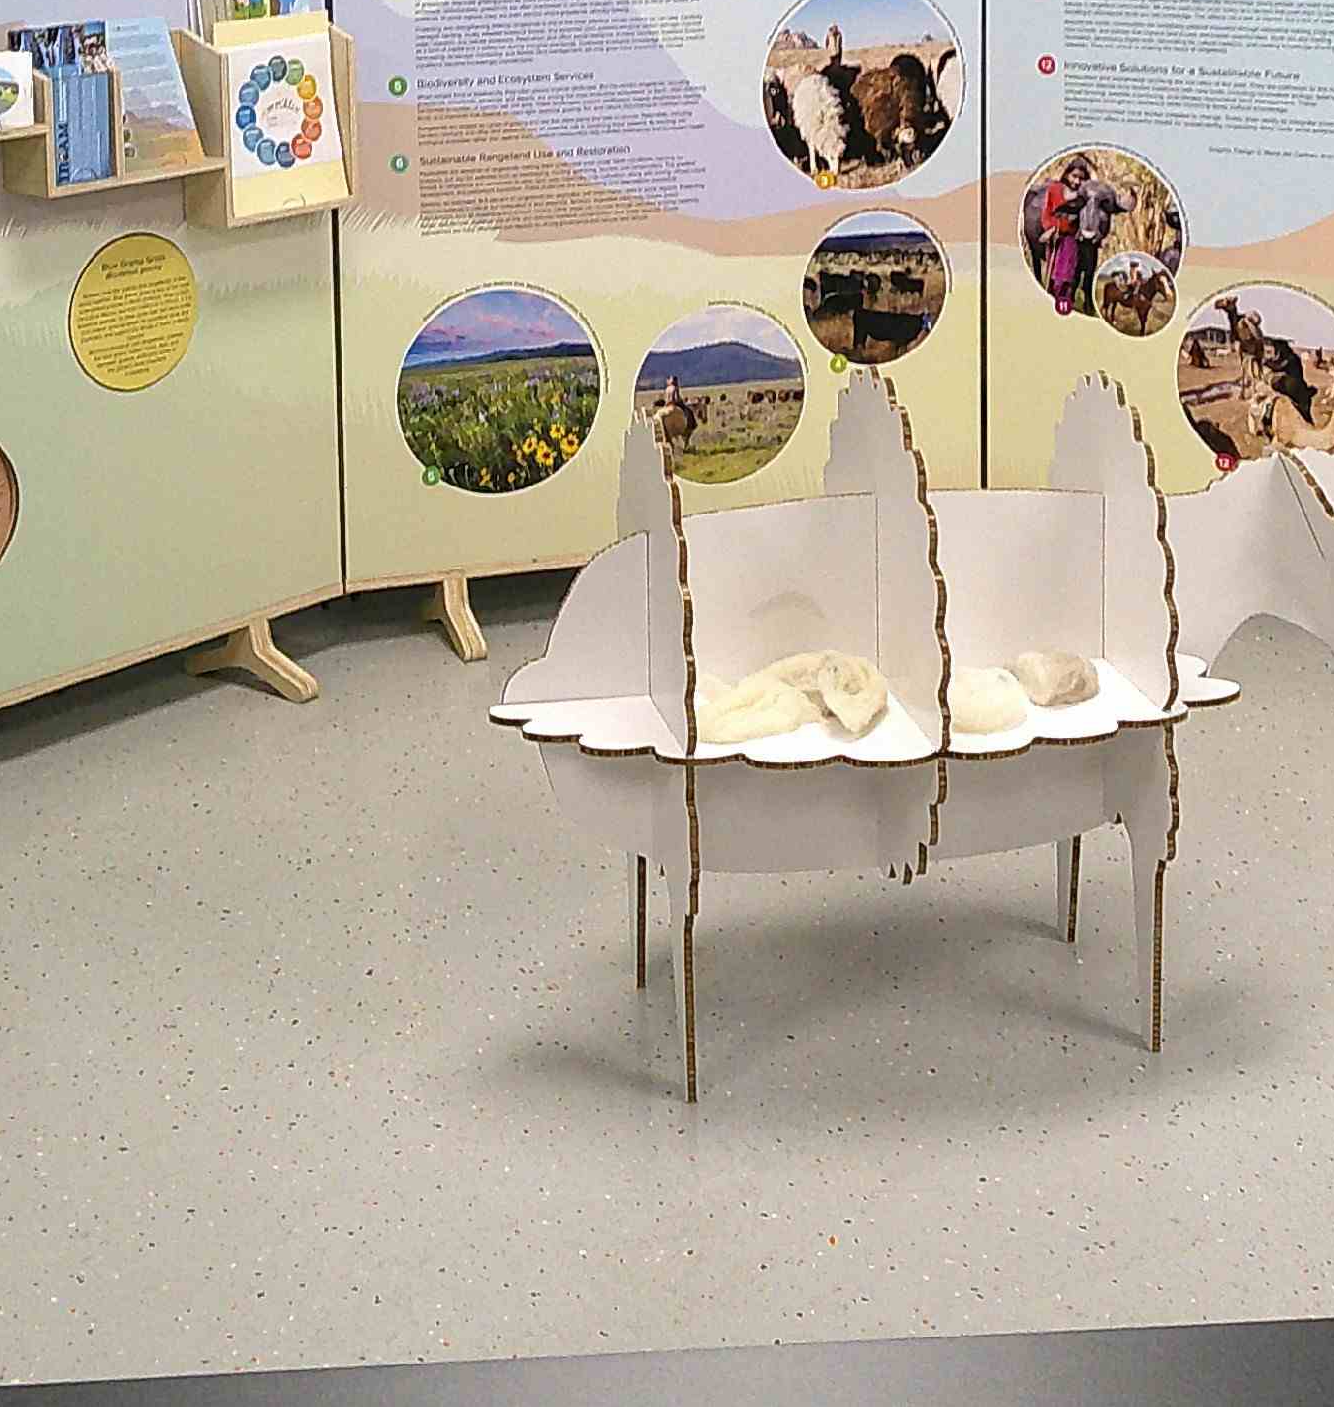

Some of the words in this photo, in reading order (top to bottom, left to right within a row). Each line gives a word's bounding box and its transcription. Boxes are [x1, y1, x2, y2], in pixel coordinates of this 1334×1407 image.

[477, 75, 496, 86] and
[498, 73, 551, 87] Ecosystem
[554, 71, 594, 82] Services
[419, 155, 477, 167] Sustainable
[479, 151, 531, 165] Rangeland
[533, 149, 554, 160] Use
